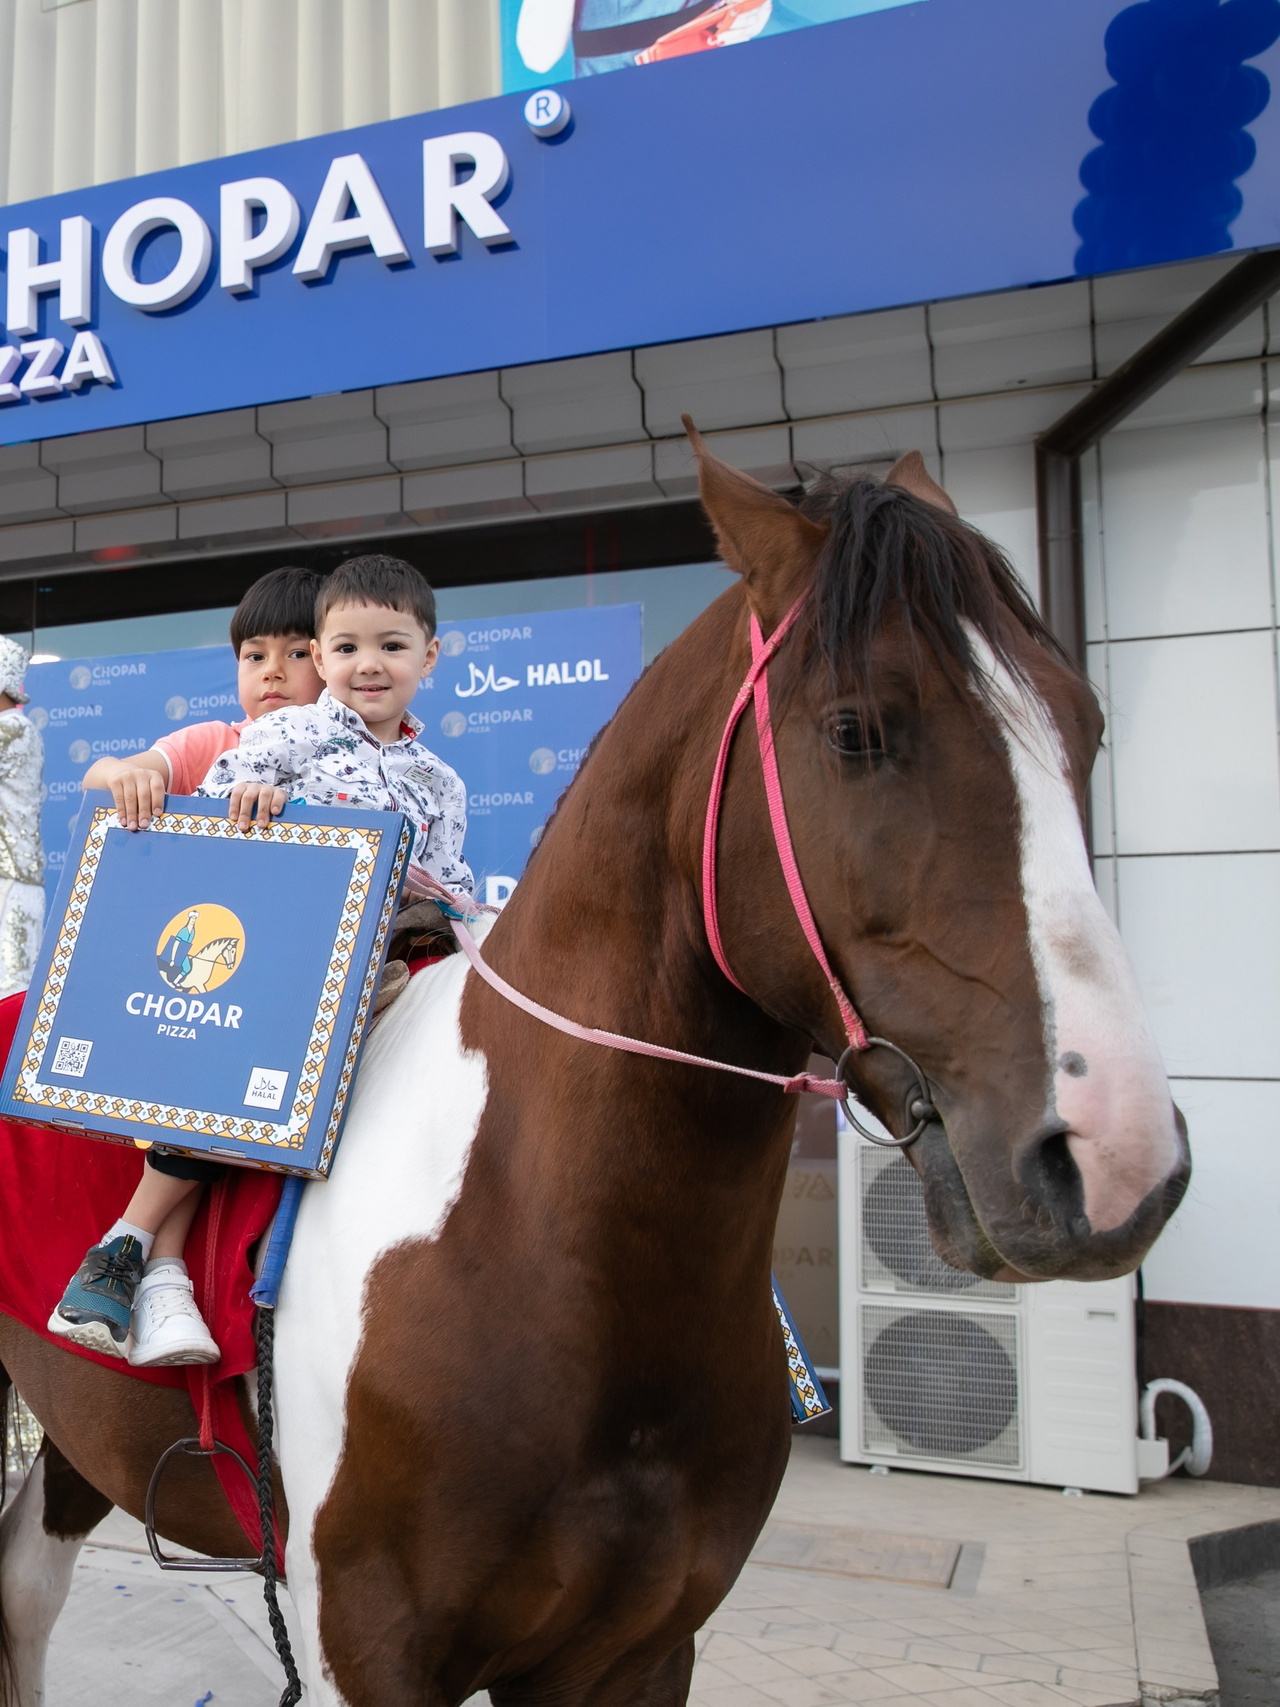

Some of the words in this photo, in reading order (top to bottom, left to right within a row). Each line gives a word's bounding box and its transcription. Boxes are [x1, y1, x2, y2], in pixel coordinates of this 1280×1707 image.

[467, 626, 533, 645] CHOPAR
[91, 662, 147, 679] CHOPAR
[526, 658, 610, 687] HALOL
[455, 662, 520, 698] حلال
[189, 694, 239, 710] CHOPA
[48, 705, 103, 720] CHOPAR
[468, 709, 533, 725] CHOPAR
[91, 738, 147, 753] CHOPAR
[469, 792, 534, 807] CHOPAR
[125, 991, 244, 1029] CHOPAR
[156, 1023, 197, 1040] PIZZA
[251, 1090, 277, 1100] HALAL
